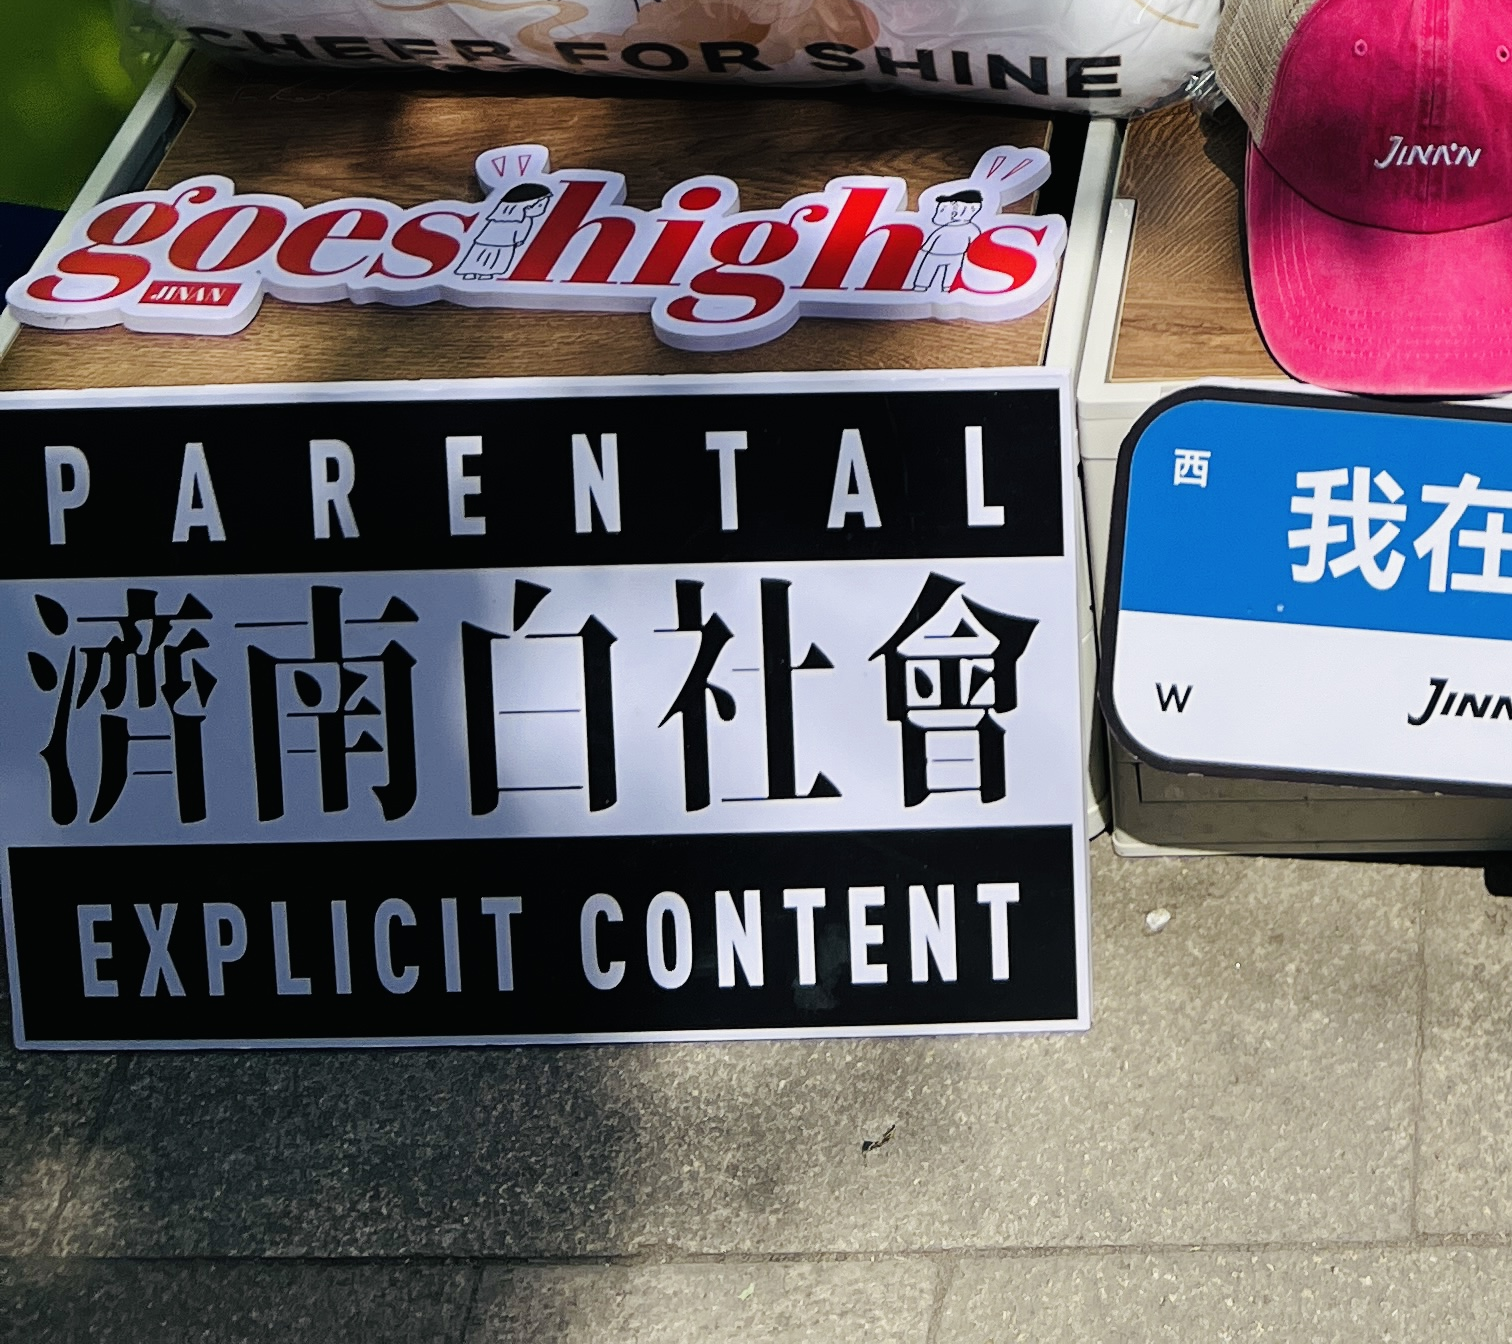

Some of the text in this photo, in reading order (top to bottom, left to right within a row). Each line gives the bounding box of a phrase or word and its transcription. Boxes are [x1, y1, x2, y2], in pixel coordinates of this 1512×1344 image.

[186, 24, 1123, 100] CHEER FOR SHINE
[148, 285, 229, 304] JINAN
[45, 425, 1006, 546] PARENTAL
[1173, 448, 1212, 488] 西
[28, 573, 1040, 827] 濟南白社會
[1156, 684, 1192, 714] W
[79, 882, 1021, 998] EXPLICIT CONTENT
